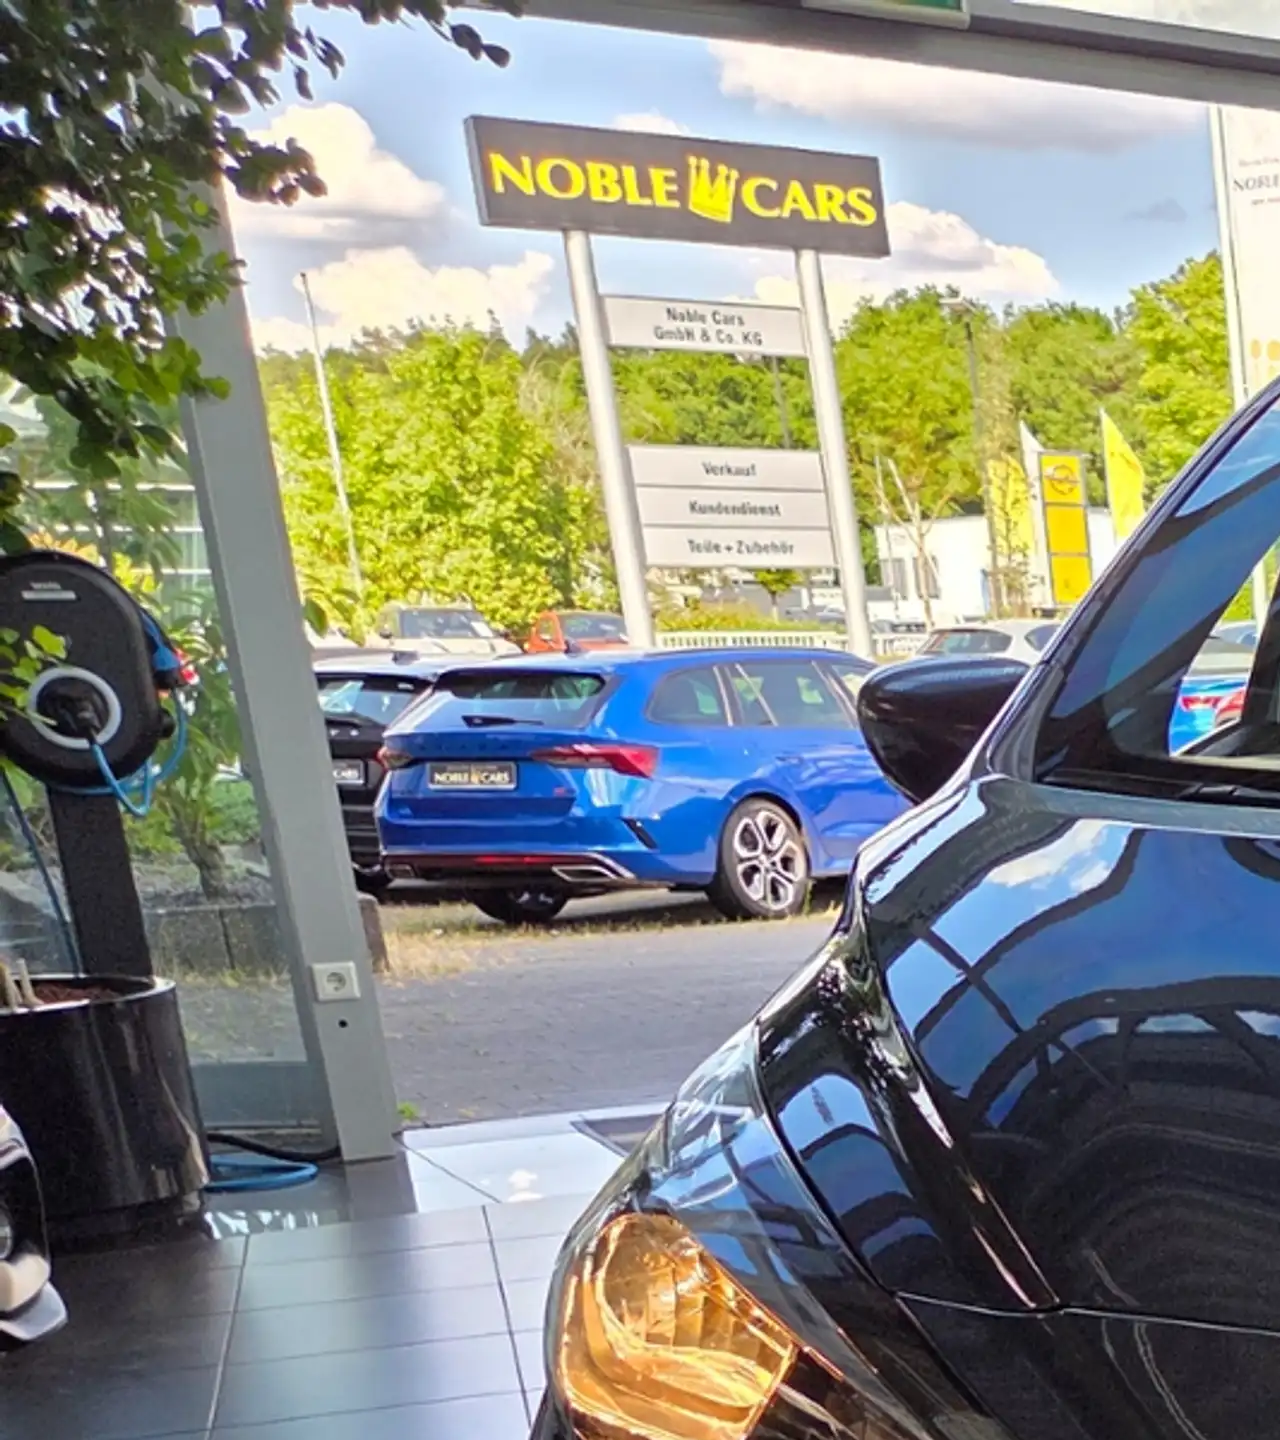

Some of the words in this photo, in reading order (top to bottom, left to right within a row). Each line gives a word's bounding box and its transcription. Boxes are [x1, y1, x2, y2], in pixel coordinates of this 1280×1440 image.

[488, 152, 681, 209] NOBLE
[740, 176, 878, 227] CARS
[665, 307, 707, 325] Noble
[711, 309, 745, 327] Cars
[653, 325, 696, 342] GmbH
[700, 327, 711, 343] &
[741, 331, 764, 346] KG
[701, 461, 757, 477] Verkauf
[689, 499, 782, 517] Kundendienst
[687, 538, 721, 554] Teile
[433, 771, 469, 784] NOBLE
[481, 770, 510, 784] CARS
